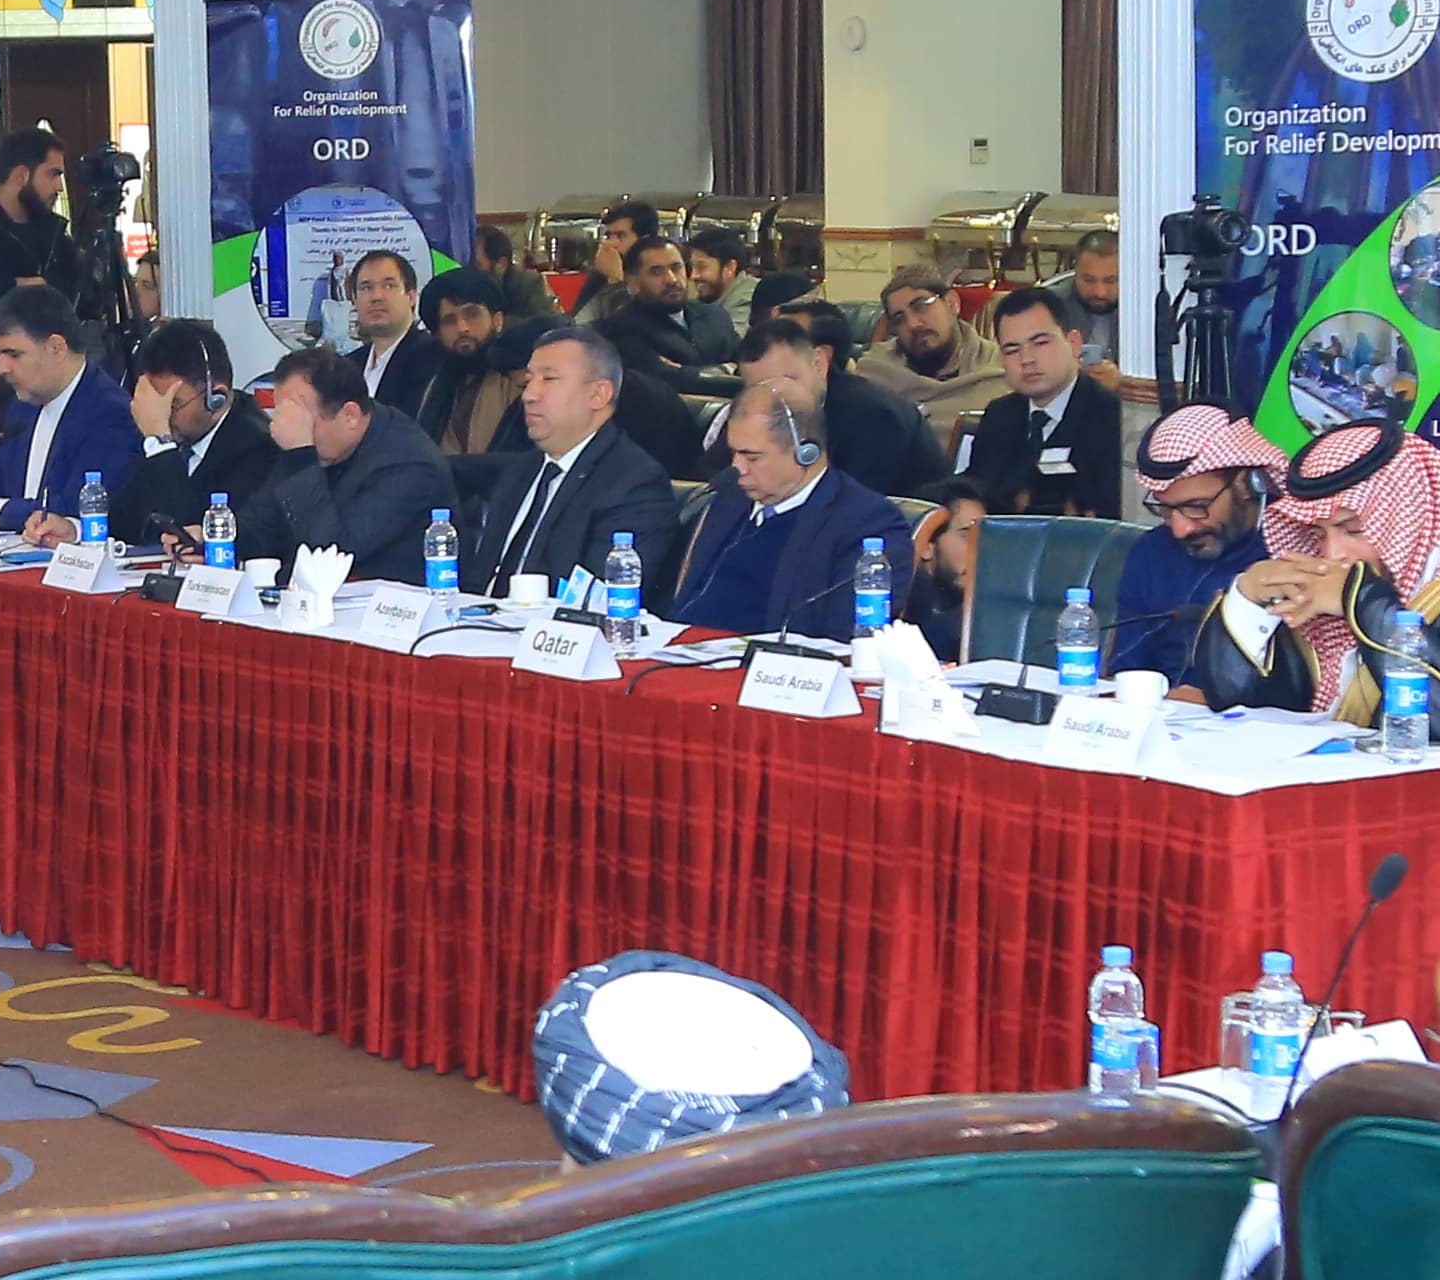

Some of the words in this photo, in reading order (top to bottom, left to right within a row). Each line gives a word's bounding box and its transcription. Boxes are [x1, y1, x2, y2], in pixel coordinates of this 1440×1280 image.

[1347, 14, 1372, 35] ORD
[303, 89, 378, 104] Organization
[273, 105, 292, 118] For
[295, 104, 328, 117] Relief
[330, 103, 408, 117] Development
[1224, 102, 1367, 133] Organization
[313, 138, 370, 161] ORD
[1224, 135, 1259, 157] For
[1265, 131, 1327, 155] Relief
[532, 630, 579, 657] Qatar
[754, 670, 787, 688] Saudi
[789, 675, 823, 693] Arabia
[1063, 717, 1094, 734] Saudi
[1095, 723, 1131, 740] Arabia
